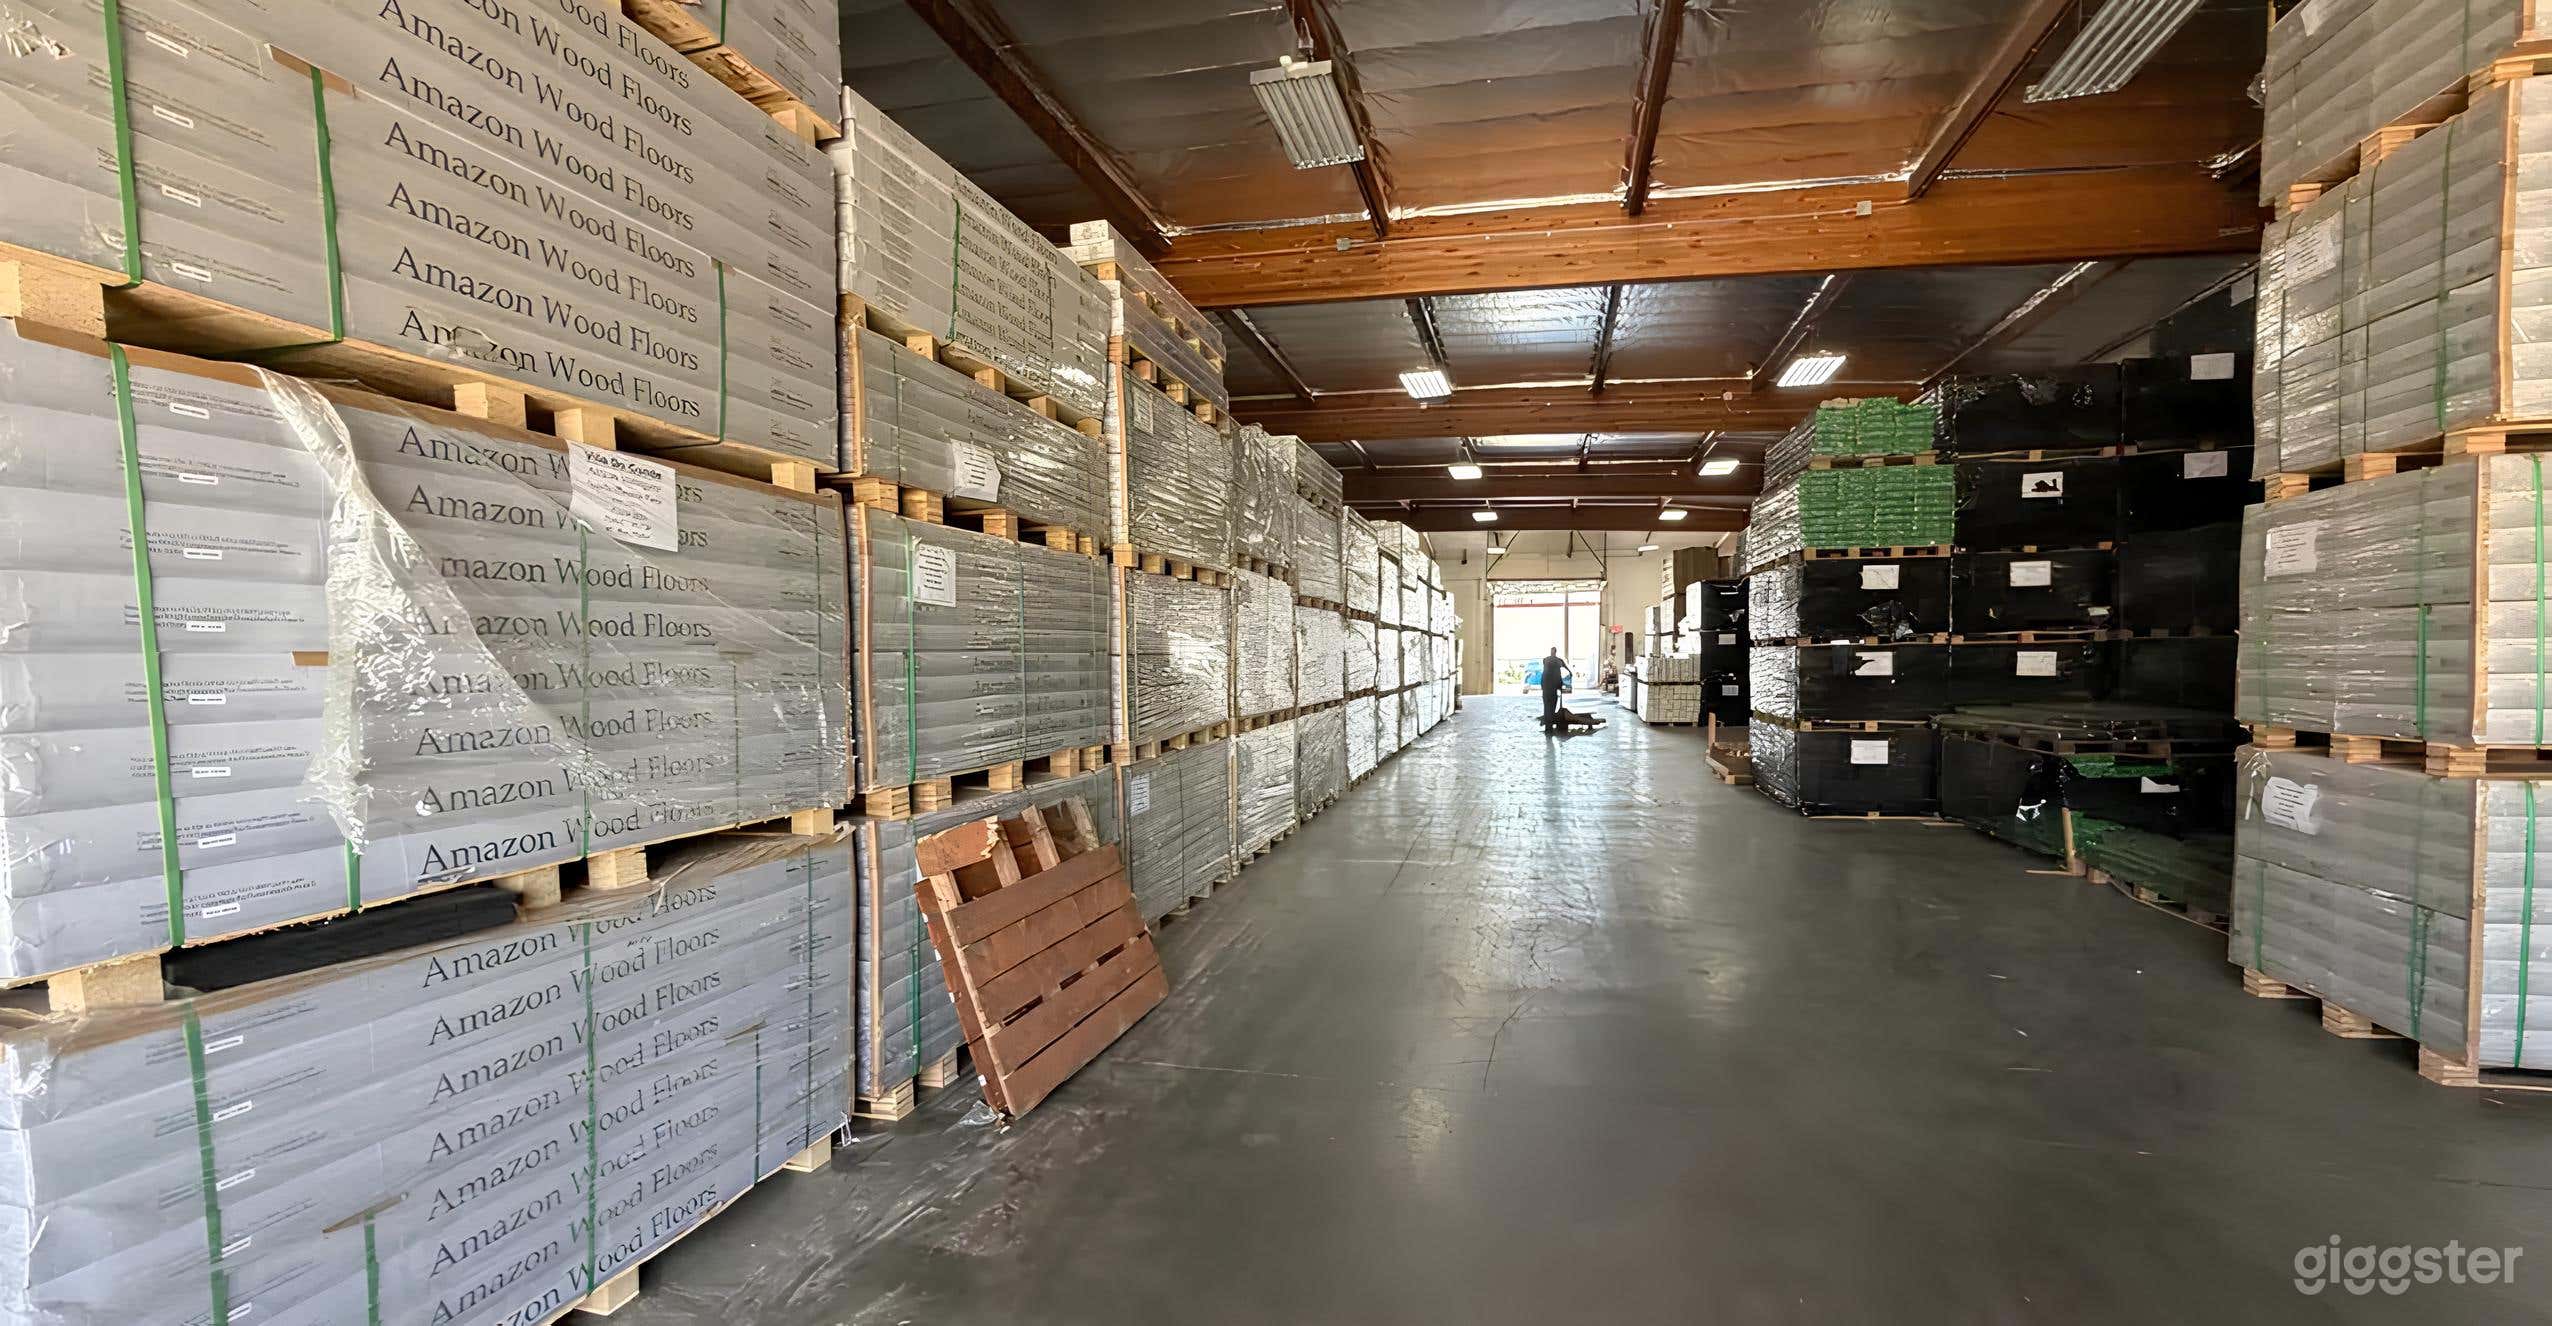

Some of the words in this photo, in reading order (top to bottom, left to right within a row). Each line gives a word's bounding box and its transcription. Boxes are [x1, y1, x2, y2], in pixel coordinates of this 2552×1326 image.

[529, 15, 613, 91] Wood
[622, 72, 693, 137] Floors
[559, 0, 610, 40] ood
[618, 22, 690, 90] Floors
[378, 0, 525, 95] Amazon
[532, 72, 615, 143] Wood
[623, 124, 695, 186] Floors
[378, 56, 526, 150] Amazon
[531, 127, 615, 193] Wood
[623, 174, 695, 232] Floors
[383, 121, 530, 208] Amazon
[535, 185, 617, 245] Wood
[625, 225, 696, 279] Floors
[386, 181, 532, 261] Amazon
[538, 238, 621, 296] Wood
[628, 274, 698, 324] Floors
[391, 246, 534, 318] Amazon
[542, 295, 622, 347] Wood
[629, 326, 699, 372] Floors
[545, 351, 625, 397] Wood
[633, 376, 701, 418] Floors
[406, 484, 546, 529] Amazon
[440, 555, 547, 584] mazon
[553, 557, 634, 590] Wood
[641, 564, 712, 594] Floors
[556, 610, 635, 638] Wood
[643, 611, 713, 639] Floors
[550, 660, 637, 690] Wood
[415, 723, 552, 757] Amazon
[559, 708, 637, 744] Wood
[418, 776, 556, 814] Amazon
[420, 828, 558, 876] Amazon
[561, 808, 641, 842] Wood
[422, 931, 558, 988] Amazon
[427, 983, 563, 1047] Amazon
[570, 946, 646, 994] Wood
[655, 927, 720, 966] Floors
[432, 1034, 564, 1105] Amazon
[572, 993, 648, 1045] Wood
[655, 970, 722, 1011] Floors
[427, 1089, 562, 1164] Amazon
[653, 1015, 720, 1058] Floors
[427, 1139, 561, 1222] Amazon
[428, 1188, 562, 1279] Amazon
[566, 1230, 644, 1292] Wood
[649, 1184, 718, 1240] Floors
[429, 1239, 560, 1326] Amazon
